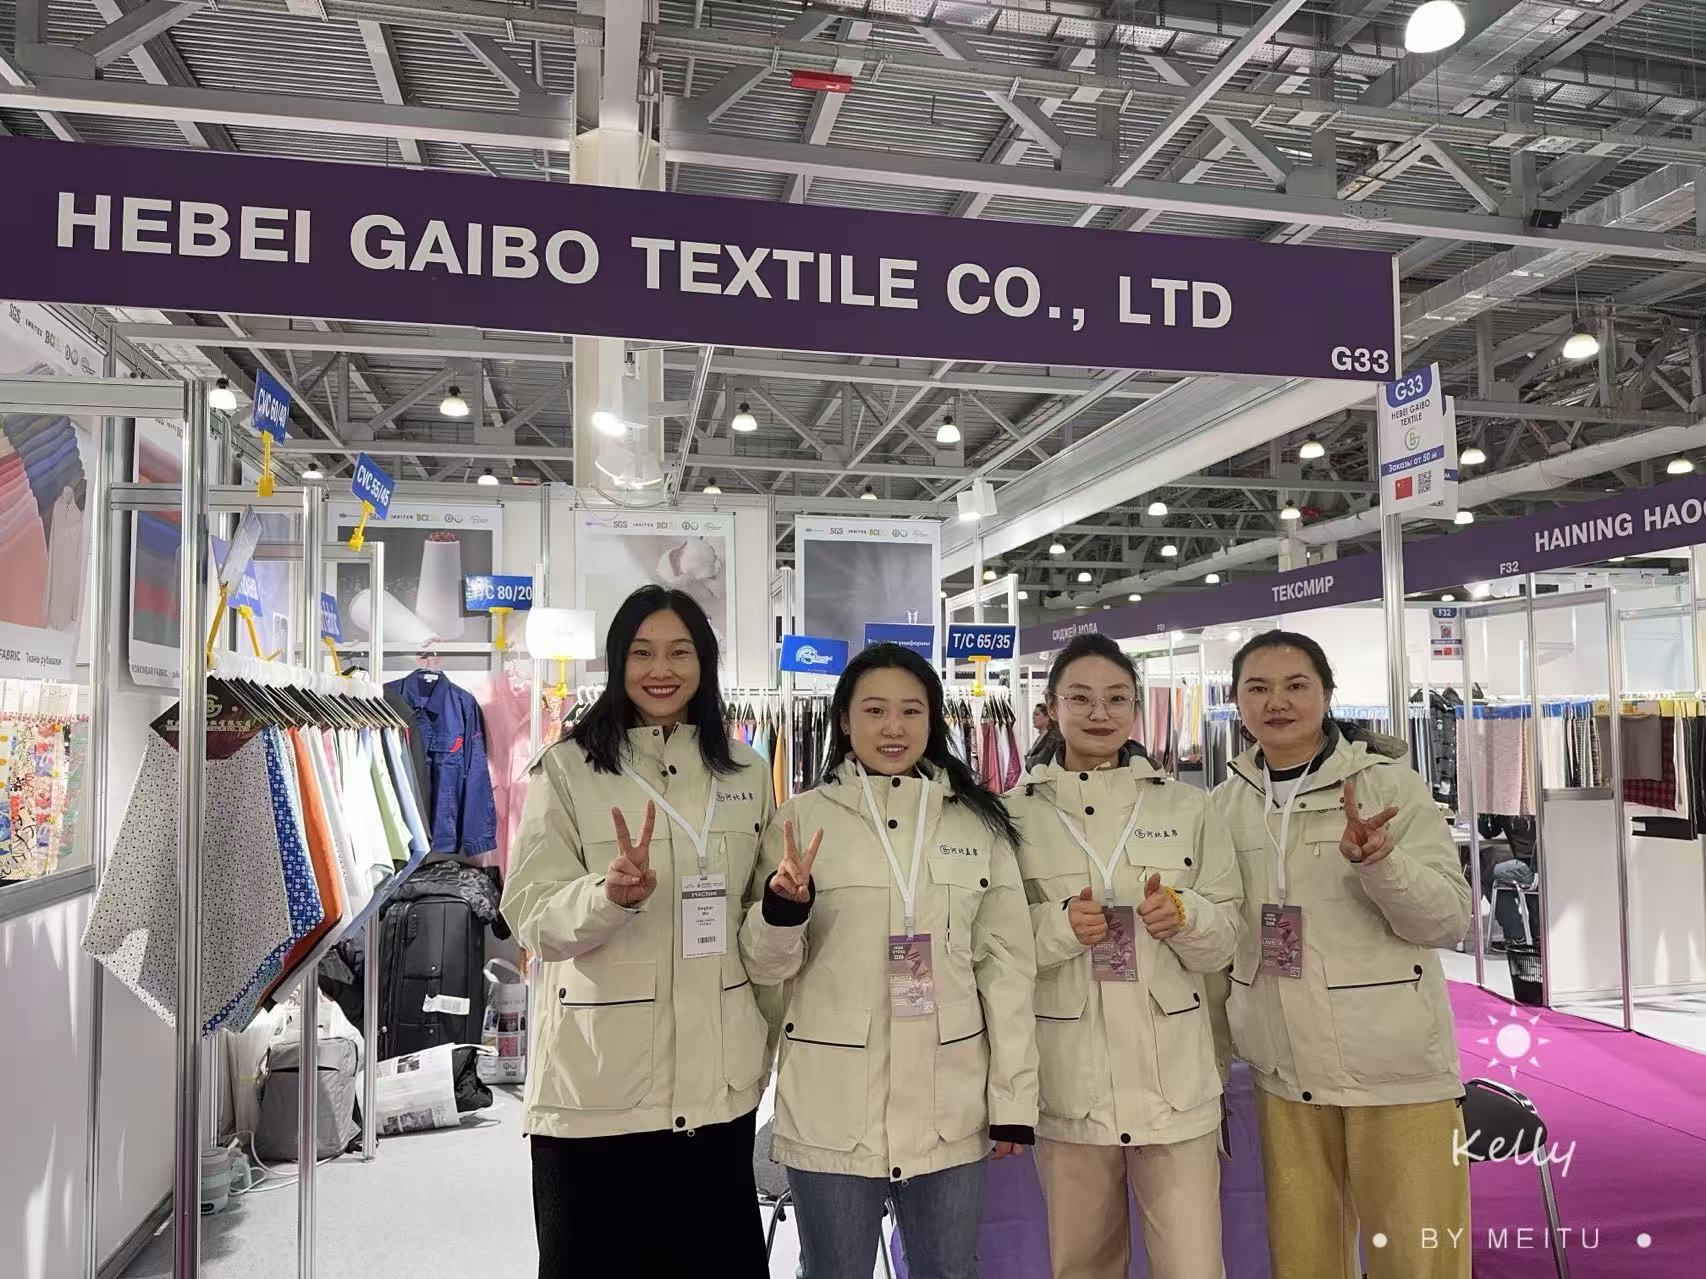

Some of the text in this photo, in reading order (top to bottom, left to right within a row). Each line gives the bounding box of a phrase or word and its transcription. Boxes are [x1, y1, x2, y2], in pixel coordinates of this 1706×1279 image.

[57, 191, 1233, 332] HEBEI GAIBO TEXTILE CO., LTD
[9, 303, 21, 324] SGS
[1331, 346, 1390, 374] G33
[1395, 374, 1423, 400] G33
[258, 388, 271, 418] CVC
[1392, 399, 1430, 420] HEBEI GAIBO
[1401, 412, 1423, 427] TEXTILE
[1388, 460, 1413, 473] Заказы
[1413, 457, 1421, 465] от
[1422, 452, 1431, 461] 50
[357, 465, 391, 506] CVC 55/45
[613, 520, 628, 529] SGS
[830, 527, 844, 535] SGS
[1535, 498, 1706, 553] HAINING HAO
[1499, 561, 1519, 575] F32
[497, 585, 532, 602] 80/20
[1271, 575, 1335, 603] ТЕКСМИР
[1438, 608, 1452, 617] F32
[953, 633, 1011, 650] T/C 65/35
